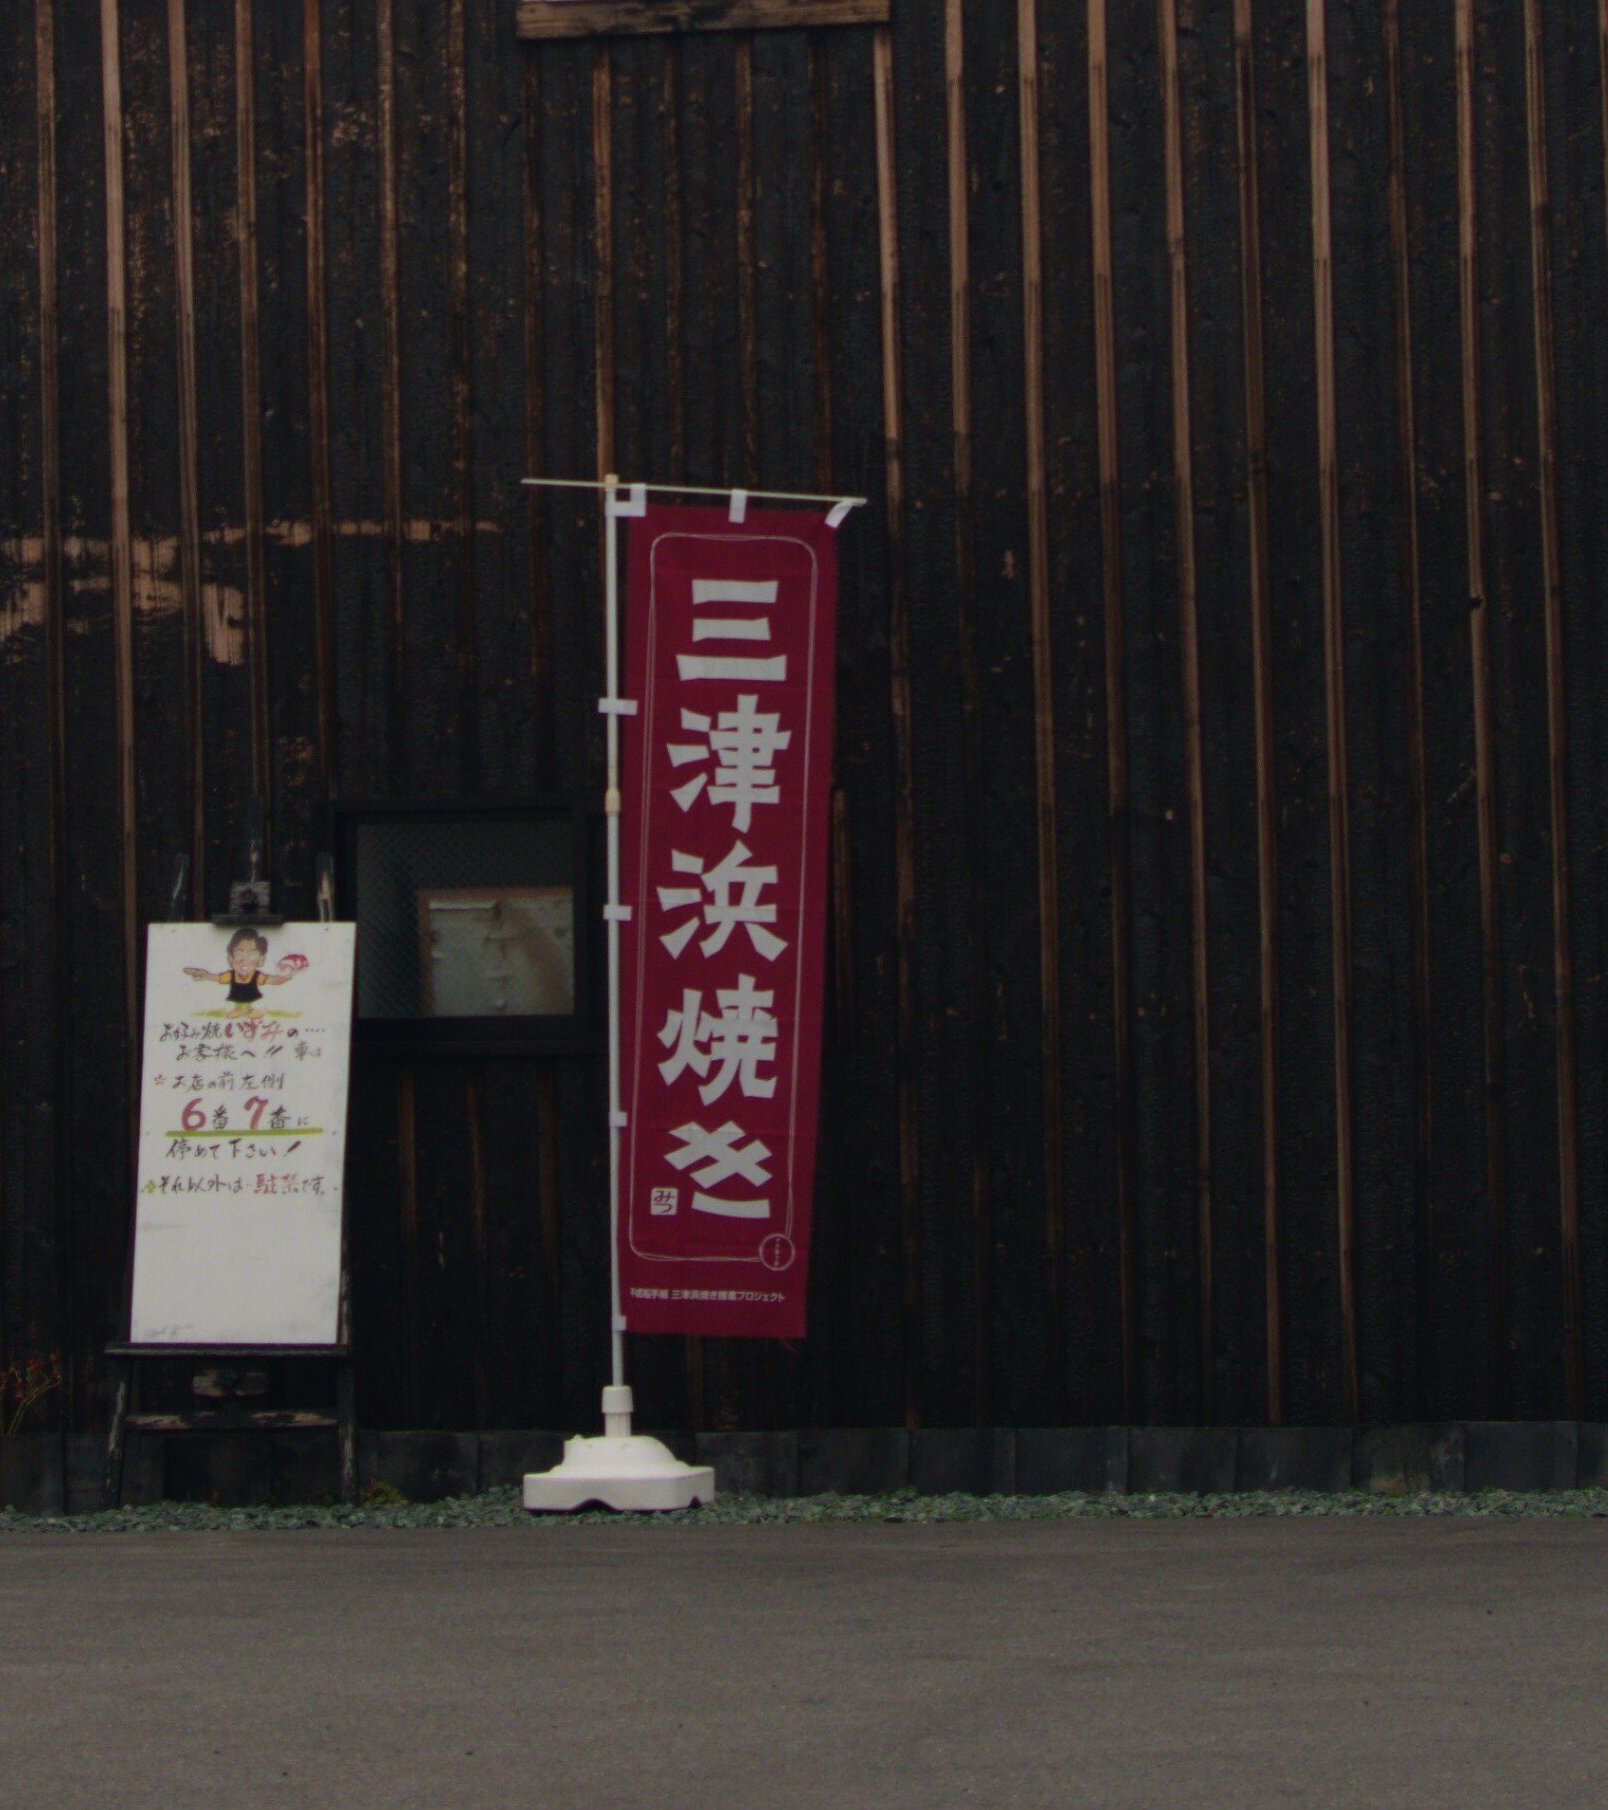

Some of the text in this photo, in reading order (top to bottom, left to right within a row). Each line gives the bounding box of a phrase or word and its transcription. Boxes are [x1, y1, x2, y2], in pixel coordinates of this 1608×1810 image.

[656, 578, 792, 1220] 三津浜焼き
